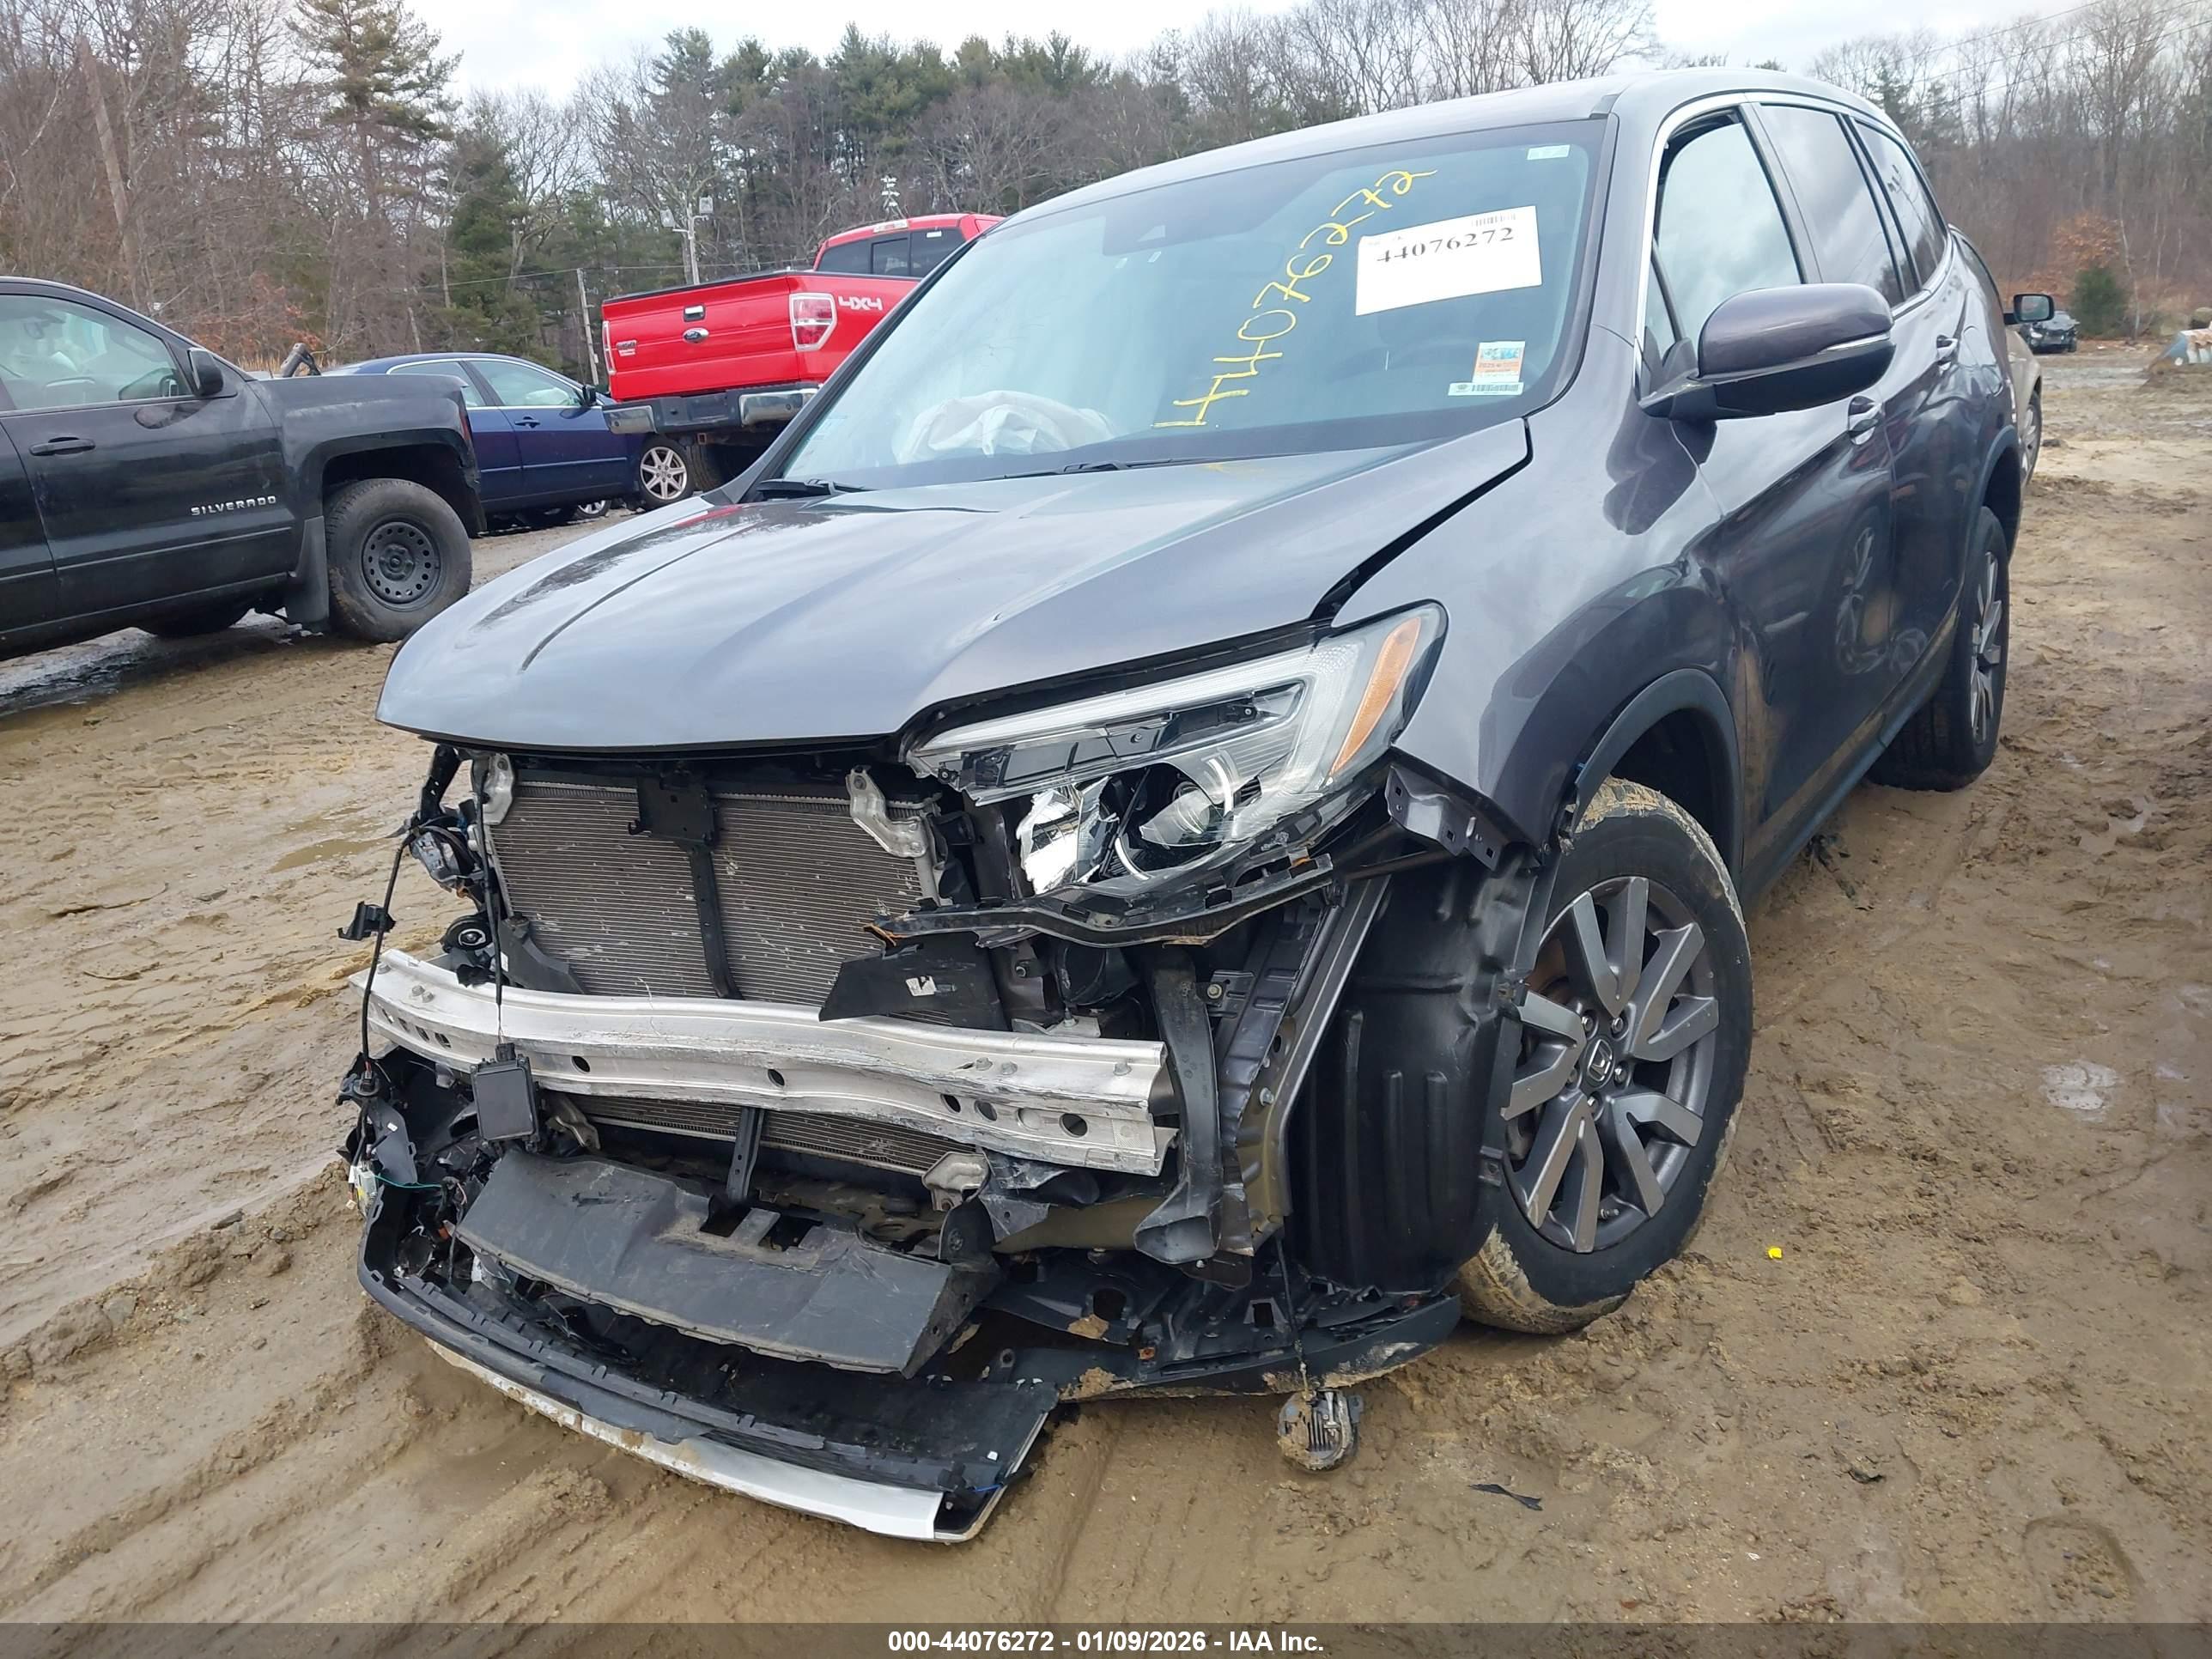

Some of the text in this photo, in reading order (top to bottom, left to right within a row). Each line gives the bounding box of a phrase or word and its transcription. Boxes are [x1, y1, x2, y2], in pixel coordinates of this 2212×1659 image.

[1376, 227, 1515, 263] 44076272
[1152, 169, 1438, 428] 44076272
[191, 495, 276, 516] SILVERADO
